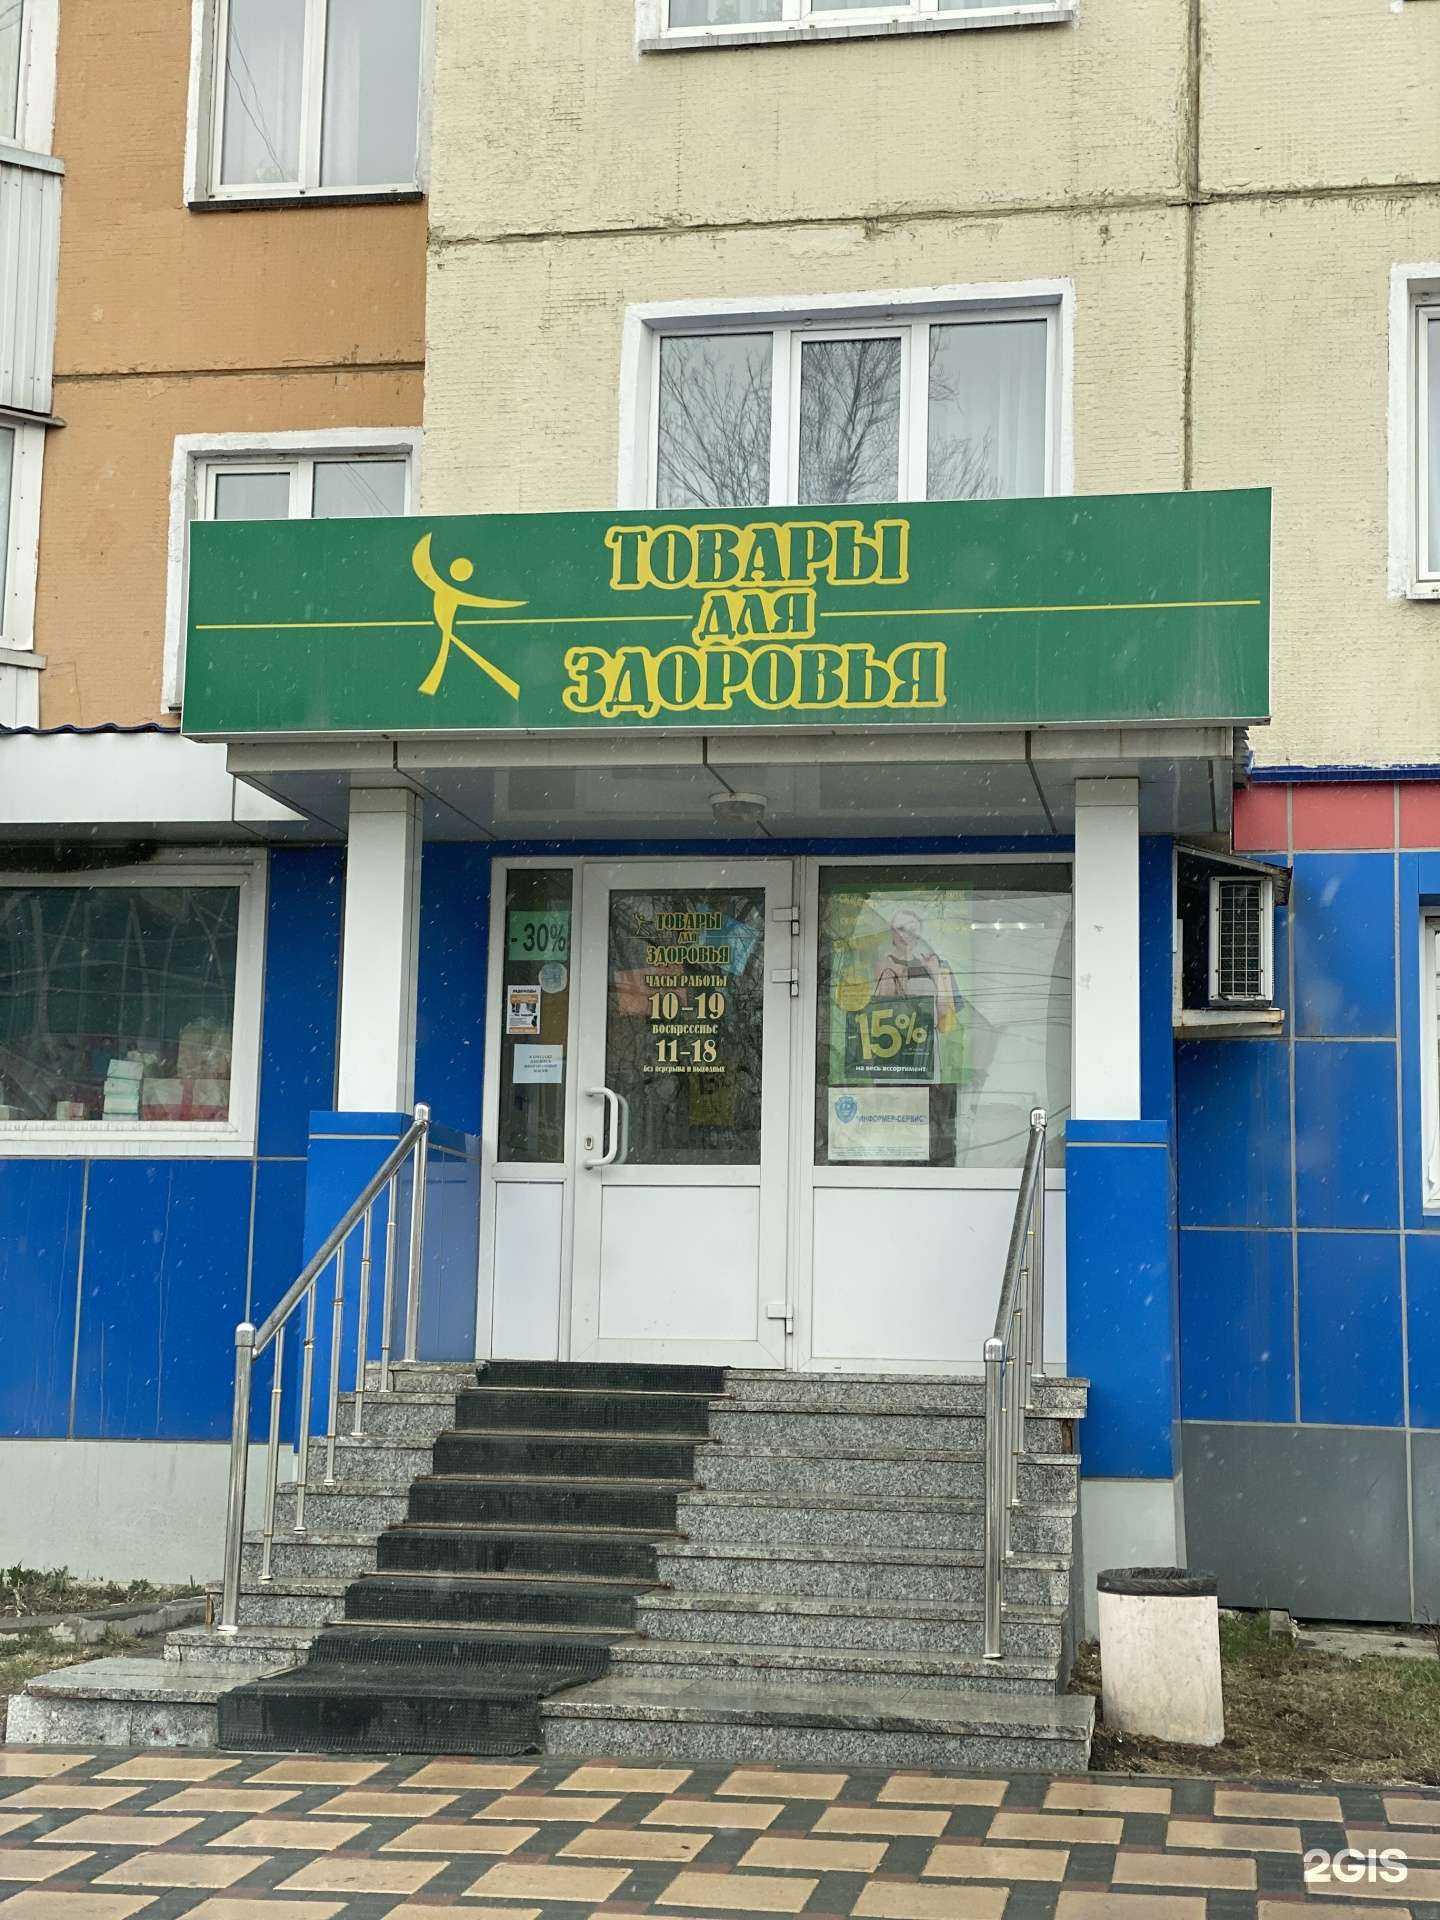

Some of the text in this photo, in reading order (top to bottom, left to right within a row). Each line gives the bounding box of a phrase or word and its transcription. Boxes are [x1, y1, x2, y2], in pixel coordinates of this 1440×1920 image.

[604, 519, 911, 590] ТОВАРЫ
[692, 587, 816, 645] ДЛЯ
[562, 642, 948, 718] ЗДОРОВЬЯ
[656, 911, 723, 931] ТОВАРЫ
[646, 945, 730, 966] ЗДОРОВЬЯ
[645, 975, 728, 987] ЧАСЫ РАБОТЫ
